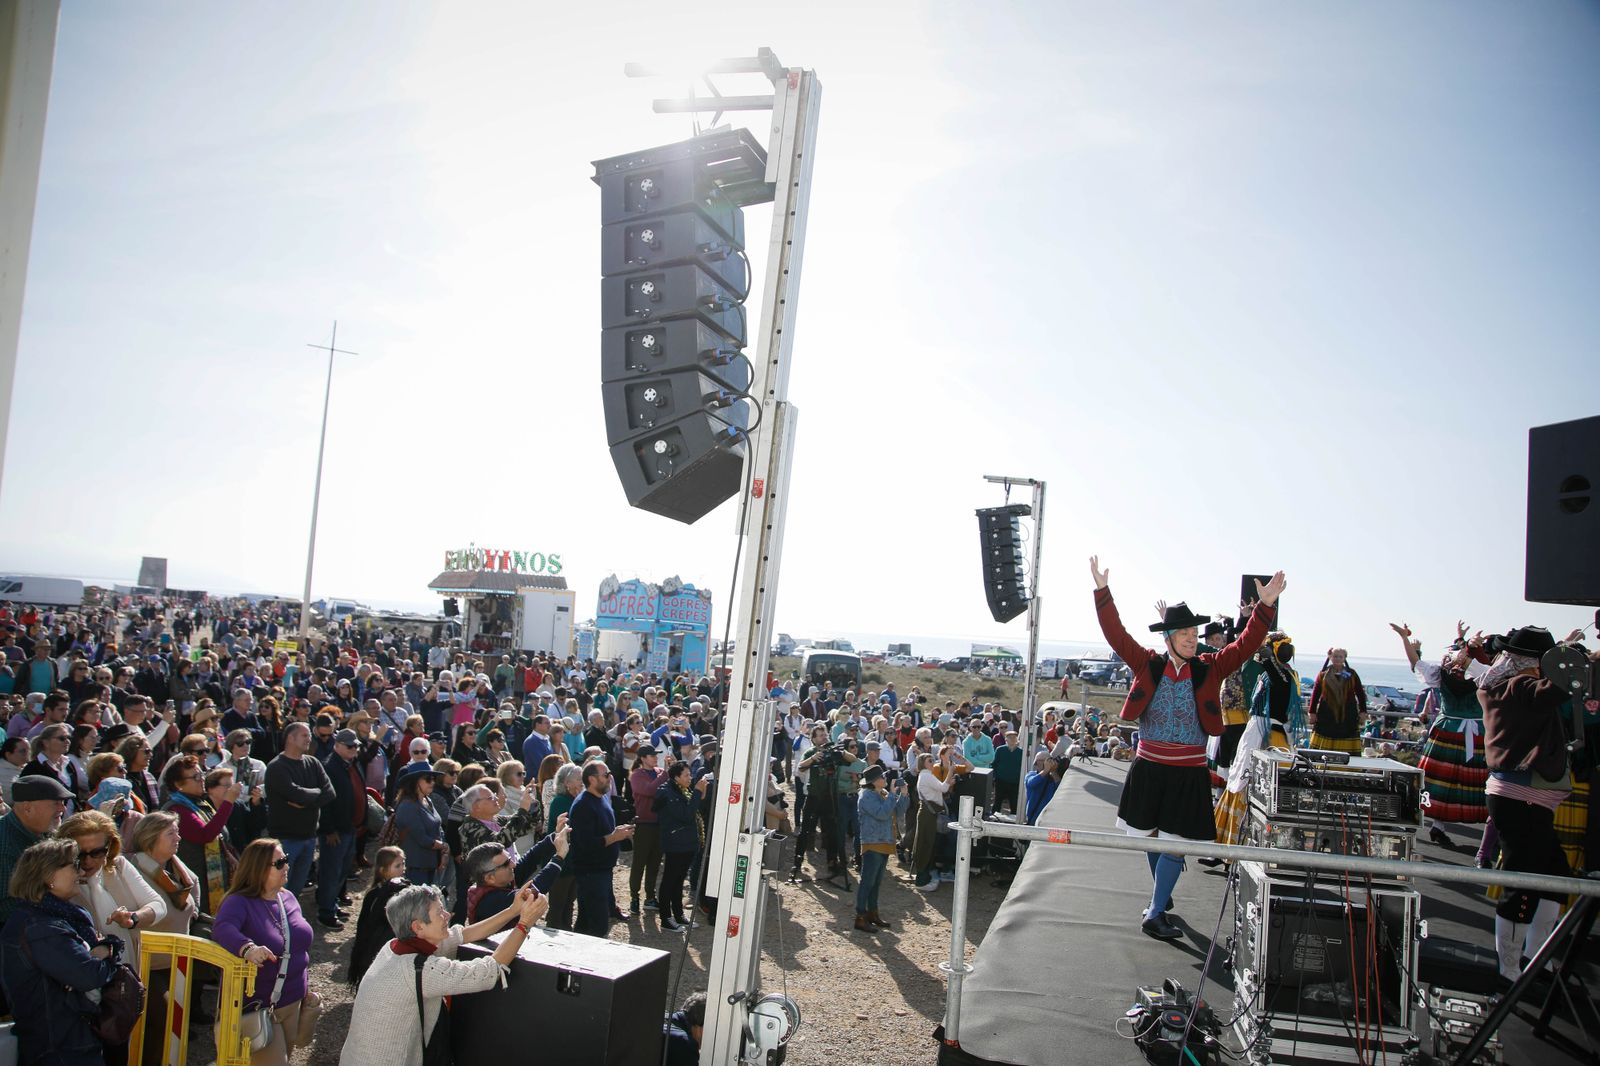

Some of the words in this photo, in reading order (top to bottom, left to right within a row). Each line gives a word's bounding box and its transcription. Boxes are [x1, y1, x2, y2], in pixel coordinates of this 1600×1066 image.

[485, 548, 562, 575] VINOS
[599, 594, 656, 616] GOFRES
[662, 597, 709, 610] GOFRES
[662, 608, 707, 622] CREPES
[736, 871, 746, 896] kuzar
